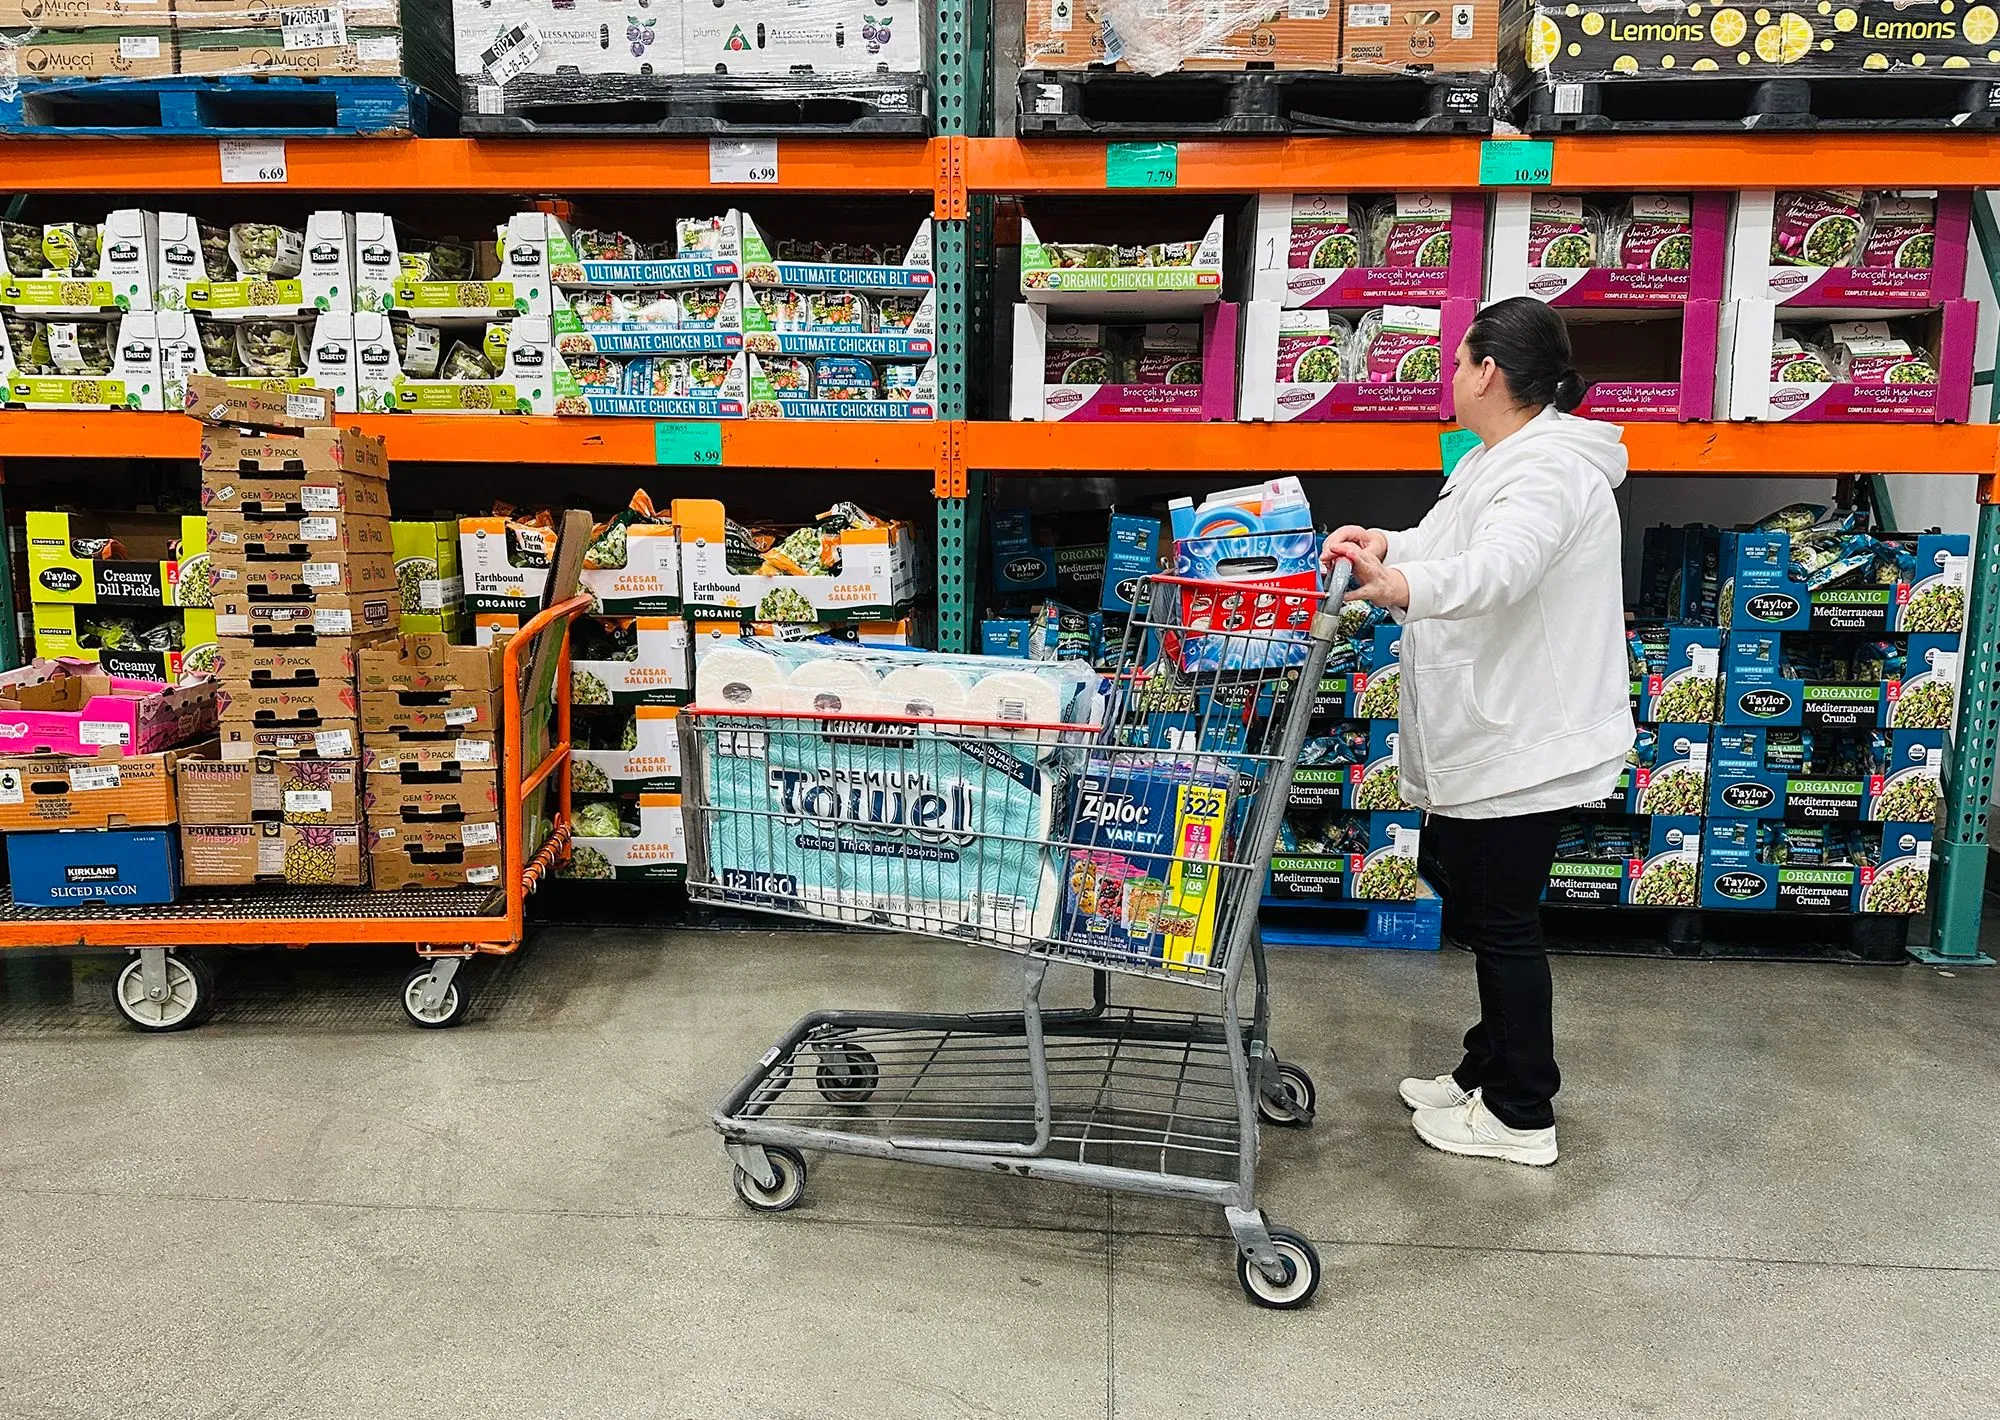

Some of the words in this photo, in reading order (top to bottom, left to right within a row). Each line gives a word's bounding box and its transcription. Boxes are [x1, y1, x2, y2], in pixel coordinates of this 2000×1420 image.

[45, 0, 90, 12] Mucci
[285, 10, 324, 26] 720650
[461, 28, 488, 38] plums
[693, 28, 721, 39] plums
[1611, 19, 1704, 42] Lemons
[1862, 18, 1956, 39] Lemons
[492, 33, 517, 58] 6021
[50, 52, 94, 66] Mucci
[274, 53, 320, 67] Mucci
[259, 168, 284, 179] 6.69
[749, 168, 775, 180] 6.99
[1147, 171, 1173, 182] 7.79
[1514, 169, 1549, 181] 10.99
[111, 251, 137, 259] Bistro
[168, 252, 193, 262] Bistro
[364, 254, 390, 262] Bistro
[512, 253, 539, 262] Bistro
[590, 265, 642, 280] ULTIMATE
[645, 264, 690, 279] CHICKEN
[694, 263, 712, 278] BLT
[716, 265, 734, 274] NEW!
[1367, 270, 1402, 279] Broccoli
[1405, 271, 1445, 279] Madness
[1851, 269, 1887, 279] Broccoli
[1888, 271, 1928, 280] Madness
[784, 269, 836, 282] ULTIMATE
[839, 269, 885, 284] CHICKEN
[889, 271, 908, 285] BLT
[912, 275, 929, 283] NEW!
[1063, 274, 1107, 288] ORGANIC
[1111, 274, 1154, 287] CHICKEN
[1157, 273, 1196, 286] CAESAR
[1199, 276, 1217, 284] NEW!
[1610, 272, 1646, 283] Broccoli
[1648, 274, 1687, 282] Madness
[125, 351, 150, 359] Bistro
[319, 352, 345, 360] Bistro
[1123, 387, 1157, 396] Broccoli
[1160, 389, 1198, 397] Madness
[226, 399, 247, 408] GEM
[262, 403, 287, 413] PACK
[595, 399, 646, 414] ULTIMATE
[650, 400, 695, 414] CHICKEN
[700, 401, 717, 414] BLT
[721, 404, 738, 412] NEW!
[693, 451, 719, 462] 8.99
[1009, 562, 1040, 572] Taylor
[44, 571, 78, 581] Taylor
[104, 570, 152, 584] Creamy
[170, 570, 177, 579] 2
[475, 572, 524, 583] Earthbound
[97, 584, 120, 596] Dill
[122, 585, 160, 597] Pickle
[476, 582, 497, 591] Farm
[693, 582, 740, 593] Earthbound
[833, 584, 871, 592] CAESAR
[693, 592, 714, 601] Farm
[828, 593, 858, 601] SALAD
[861, 593, 877, 601] KIT
[1820, 592, 1881, 602] ORGANIC
[1899, 590, 1907, 600] 2
[477, 599, 526, 608] ORGANIC
[1754, 599, 1793, 610] Taylor
[694, 609, 742, 618] ORGANIC
[1813, 607, 1884, 617] Mediterranean
[1830, 618, 1865, 627] Crunch
[109, 659, 156, 674] Creamy
[254, 658, 274, 666] GEM
[392, 675, 412, 683] GEM
[434, 674, 457, 682] PACK
[1811, 689, 1872, 698] ORGANIC
[1747, 695, 1785, 706] Taylor
[1805, 703, 1875, 713] Mediterranean
[1822, 713, 1856, 723] Crunch
[180, 764, 249, 773] POWERFUL
[818, 769, 930, 791] PREMIUM
[1794, 782, 1856, 792] ORGANIC
[1730, 788, 1768, 799] Taylor
[1789, 797, 1857, 807] Mediterranean
[771, 769, 973, 846] Towel
[1082, 795, 1150, 826] Ziploc
[1180, 798, 1220, 818] 322
[1804, 807, 1839, 817] Crunch
[1105, 828, 1164, 845] VARIETY
[1279, 859, 1337, 870] ORGANIC
[67, 867, 117, 876] KIRKLAND
[1555, 865, 1615, 875] ORGANIC
[1274, 873, 1340, 883] Mediterranean
[726, 874, 747, 889] 12
[756, 877, 793, 895] 160
[1290, 883, 1323, 893] Crunch
[1550, 879, 1617, 889] Mediterranean
[51, 886, 93, 897] SLICED
[95, 885, 137, 896] BACON
[1566, 889, 1600, 899] Crunch
